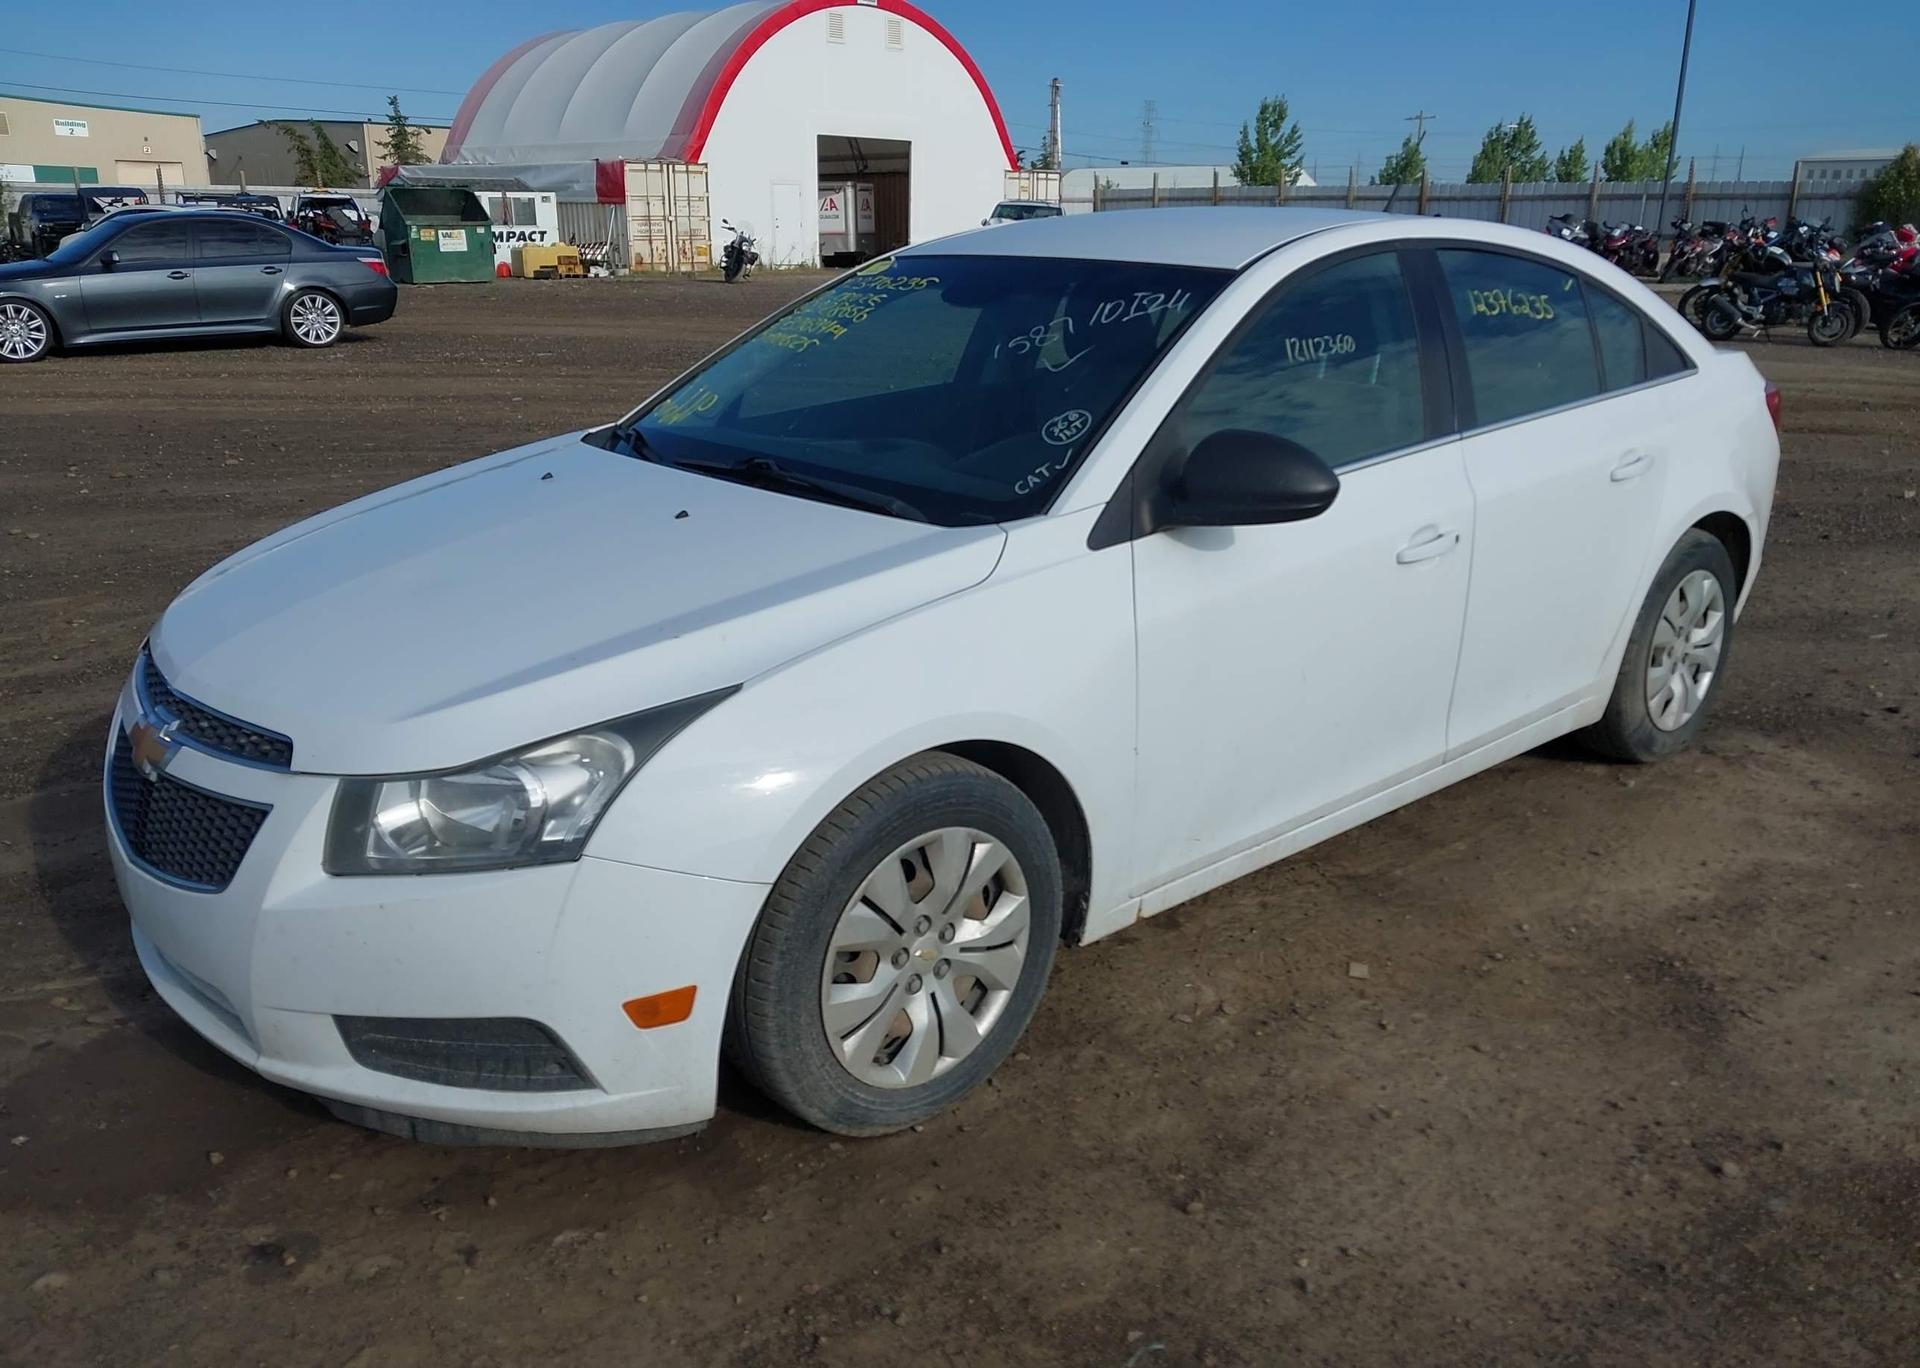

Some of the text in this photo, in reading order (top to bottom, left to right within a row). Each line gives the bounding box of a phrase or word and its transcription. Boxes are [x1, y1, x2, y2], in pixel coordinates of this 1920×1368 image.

[55, 120, 86, 128] Building
[493, 231, 547, 243] MPACT
[1014, 462, 1051, 495] CAT
